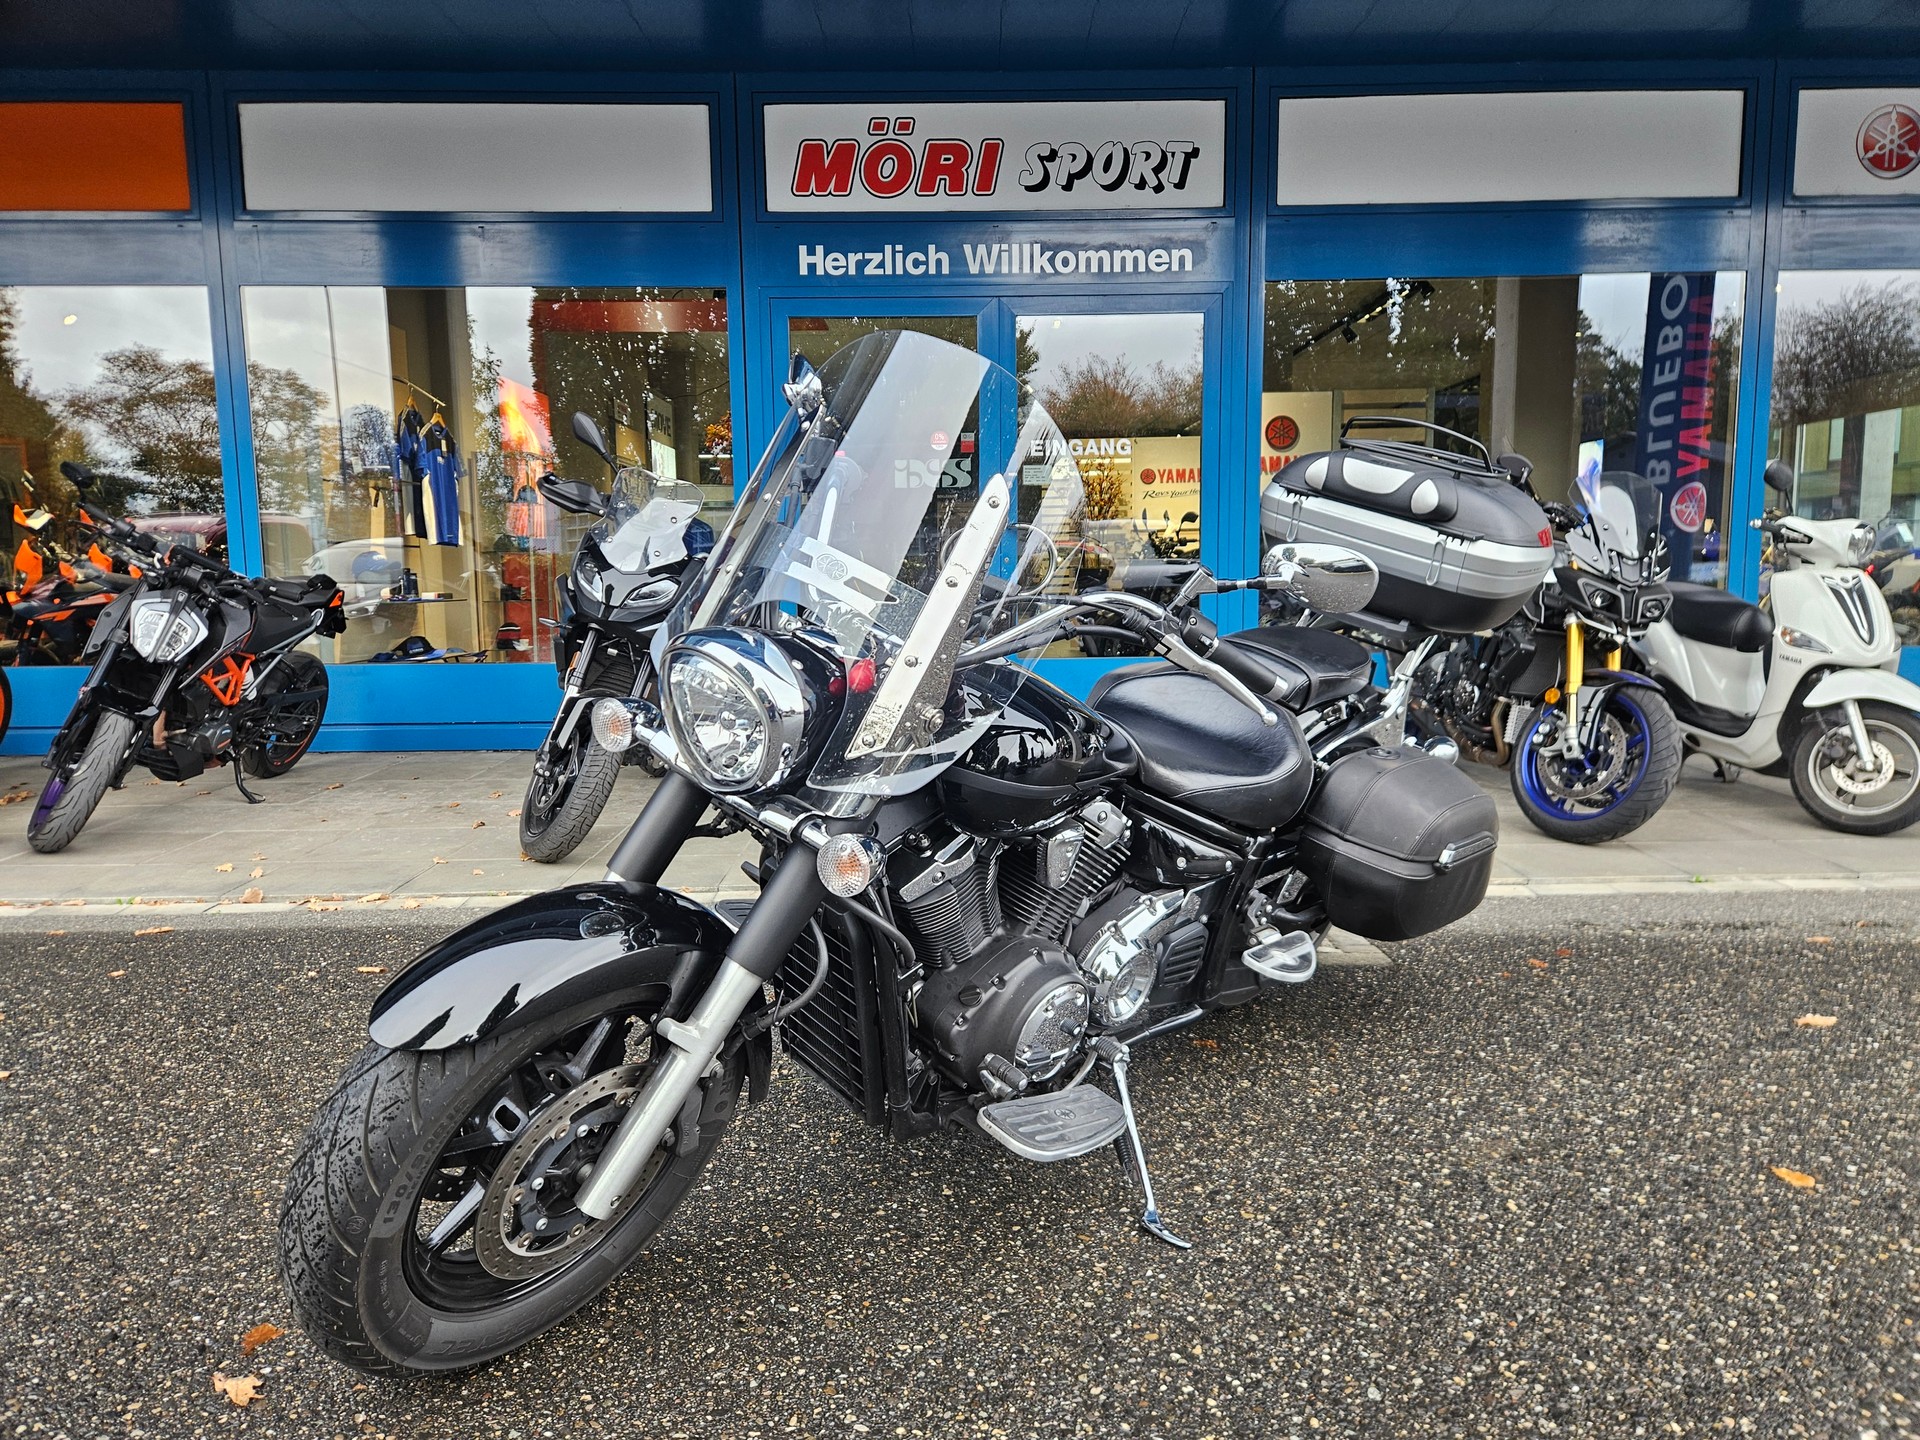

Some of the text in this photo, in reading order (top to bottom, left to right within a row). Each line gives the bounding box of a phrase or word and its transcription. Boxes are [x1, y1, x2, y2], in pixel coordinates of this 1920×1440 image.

[792, 116, 1200, 198] MÖRI SPORT
[799, 243, 1193, 276] Herzlich Willkommen
[1646, 274, 1689, 486] BLUEBO
[1676, 294, 1721, 478] YAMAHA
[1030, 438, 1132, 456] EINGANG
[1779, 653, 1802, 664] YAMAHA
